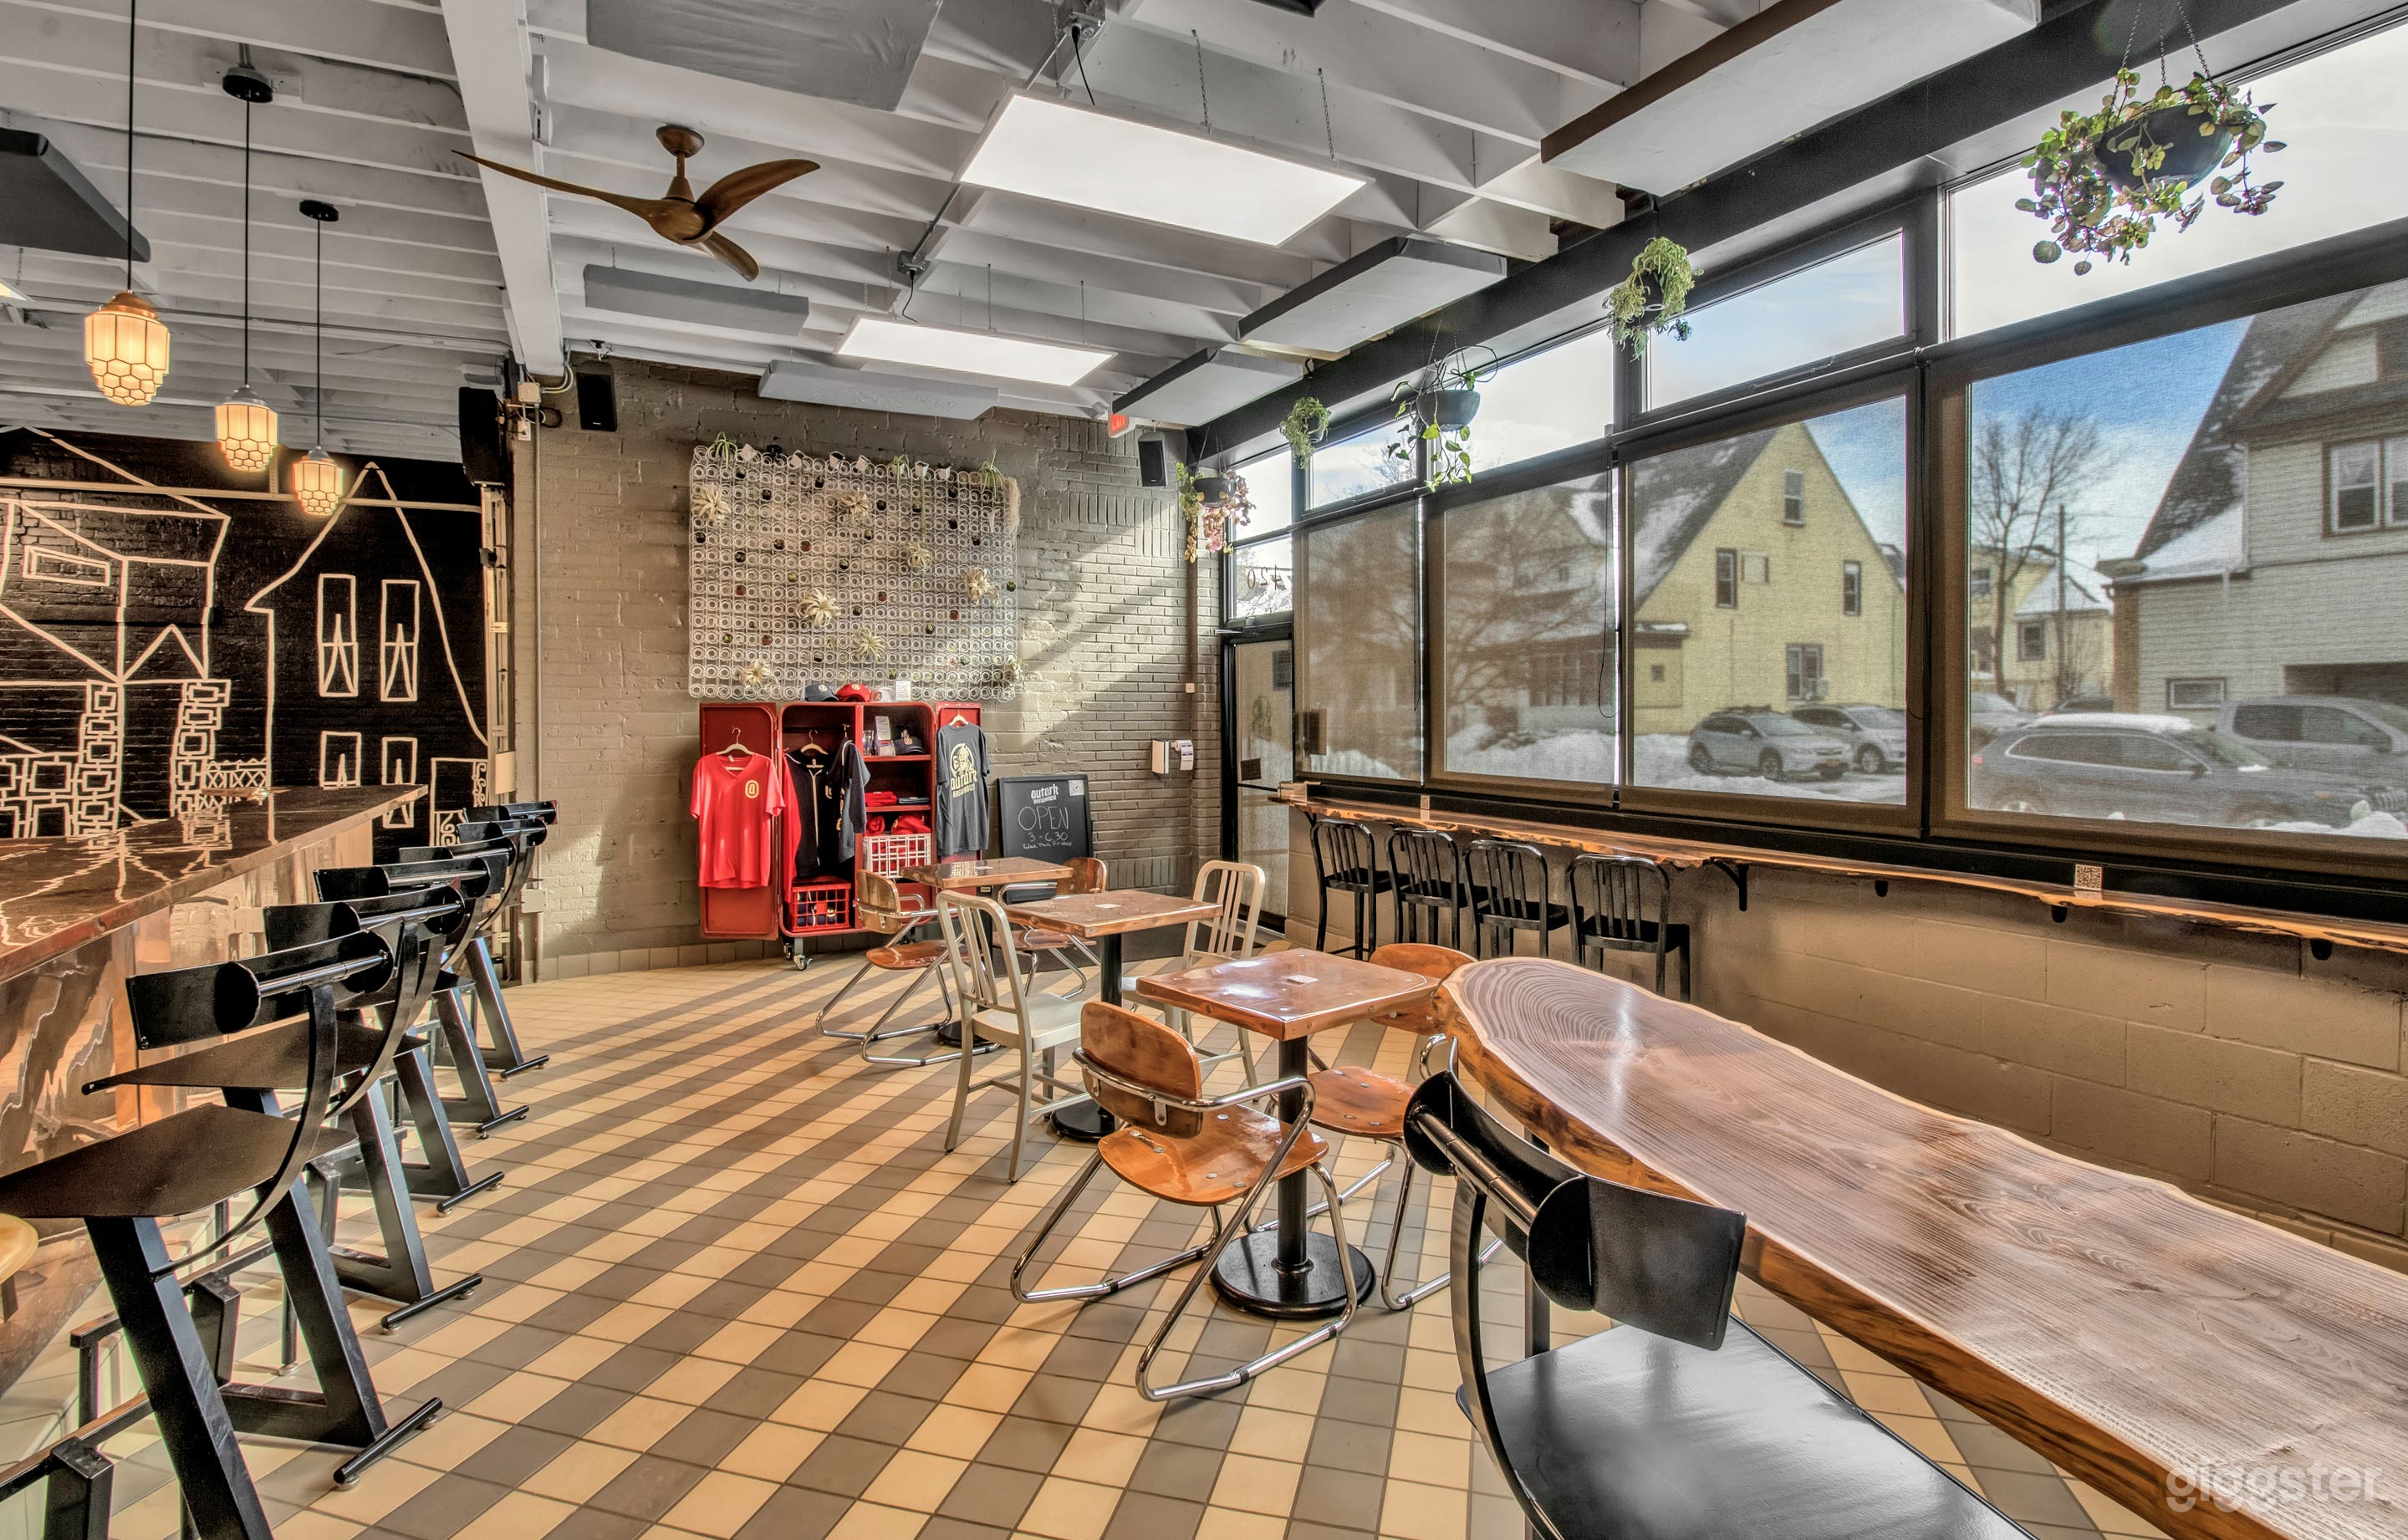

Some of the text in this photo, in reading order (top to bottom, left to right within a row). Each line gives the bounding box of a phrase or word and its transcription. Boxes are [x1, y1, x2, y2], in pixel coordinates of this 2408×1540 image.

[1031, 783, 1059, 799] autark
[1018, 806, 1069, 830] OPEN
[1028, 832, 1035, 842] 3
